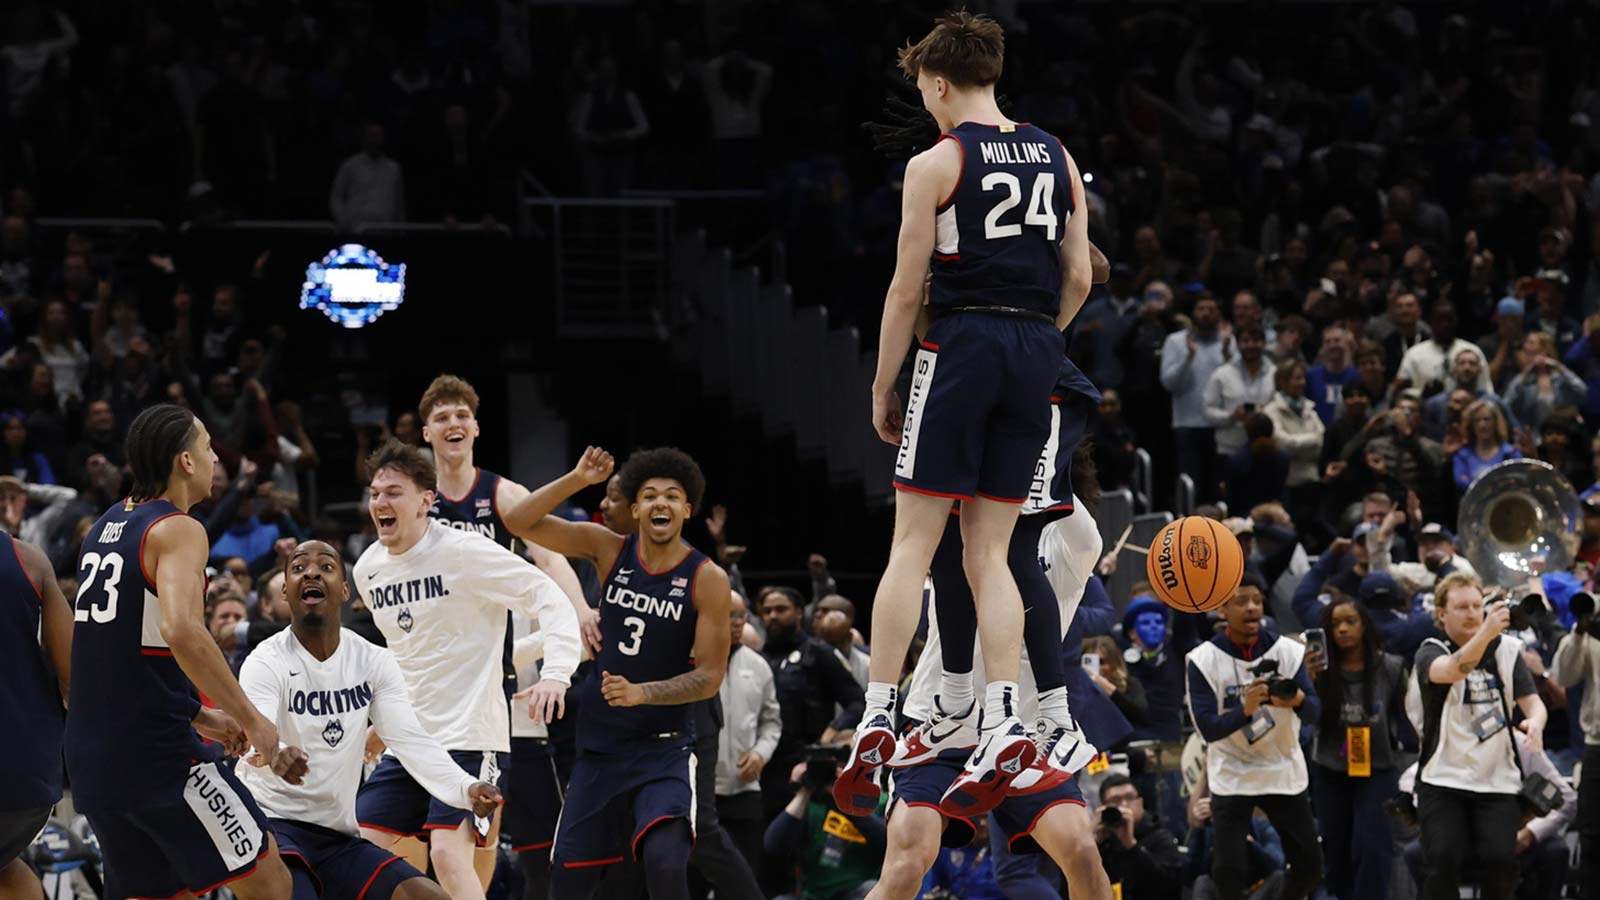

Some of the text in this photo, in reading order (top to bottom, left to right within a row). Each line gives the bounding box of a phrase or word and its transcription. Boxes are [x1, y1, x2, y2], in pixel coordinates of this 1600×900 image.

[980, 142, 1051, 163] MULLINS
[981, 172, 1058, 240] 24
[897, 359, 929, 469] HUSKIES
[1158, 527, 1179, 590] Wilson
[74, 552, 124, 624] 23
[406, 579, 421, 602] IT
[424, 574, 450, 599] IN.
[605, 584, 683, 621] UCONN
[617, 616, 646, 656] 3
[288, 688, 334, 716] LOCK
[191, 766, 253, 857] HUSKIES
